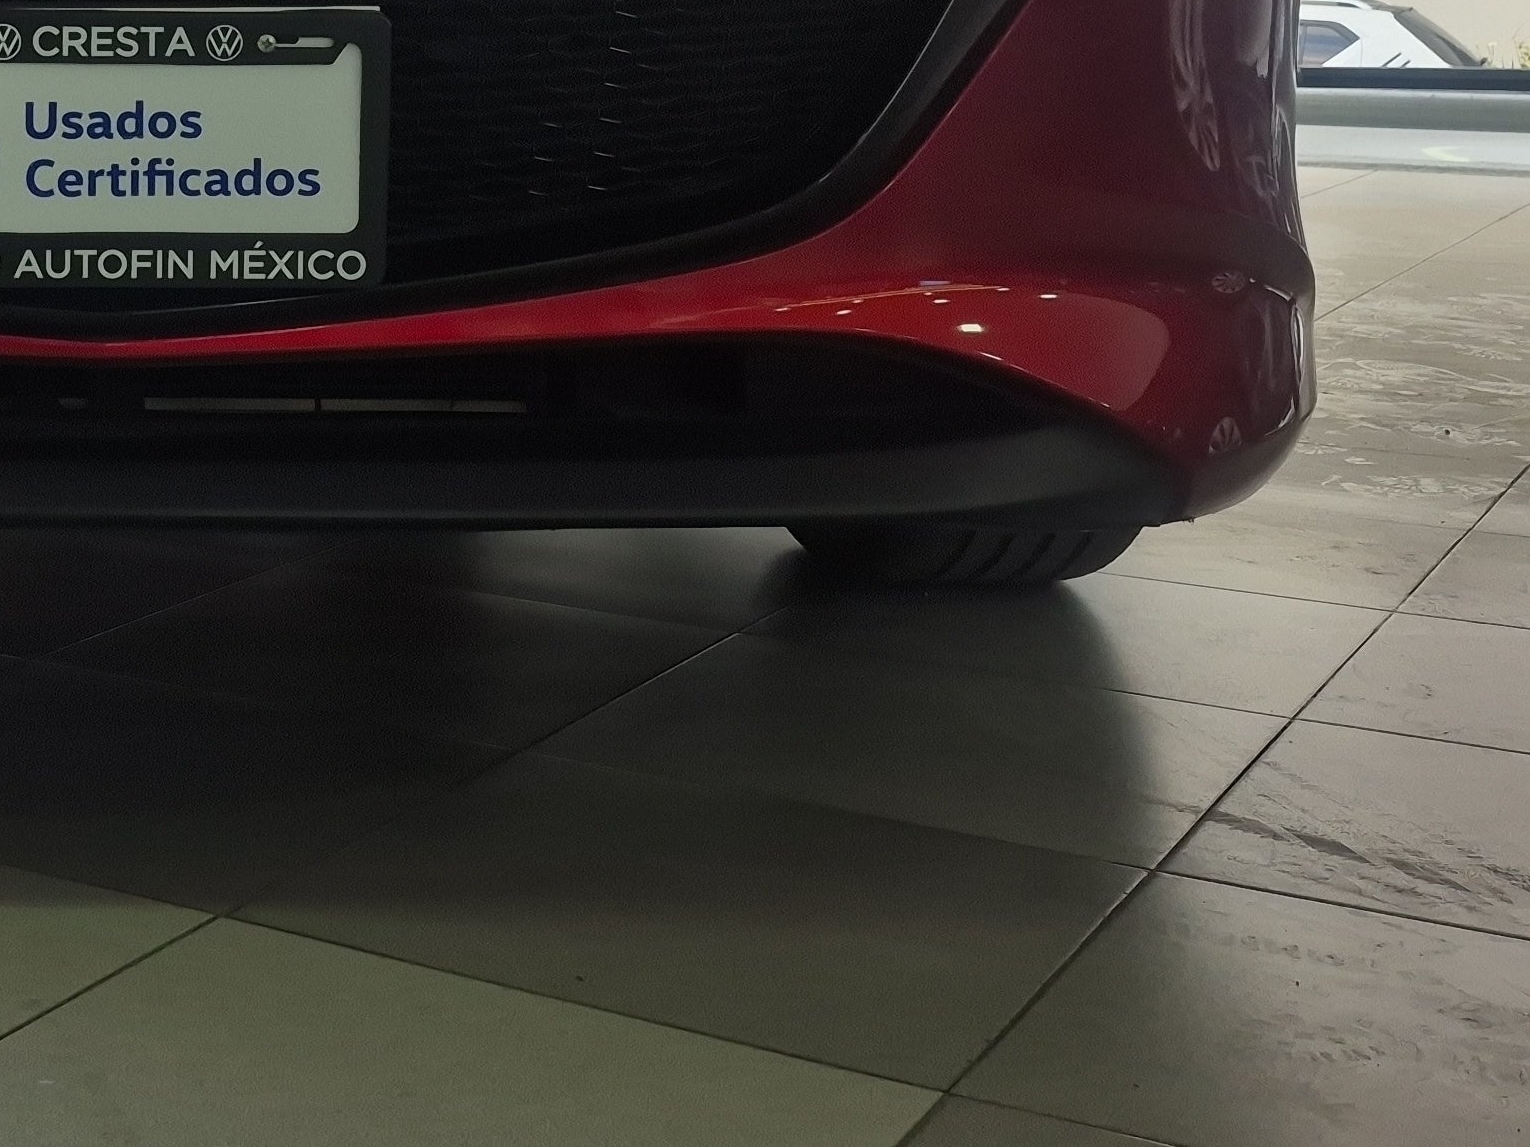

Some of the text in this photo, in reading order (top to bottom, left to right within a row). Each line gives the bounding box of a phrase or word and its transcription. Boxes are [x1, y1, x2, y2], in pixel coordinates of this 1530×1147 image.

[32, 26, 195, 57] CRESTA
[25, 100, 202, 140] Usados
[26, 157, 321, 197] Certificados
[13, 249, 194, 280] AUTOFIN
[209, 240, 367, 280] MÉXICO
